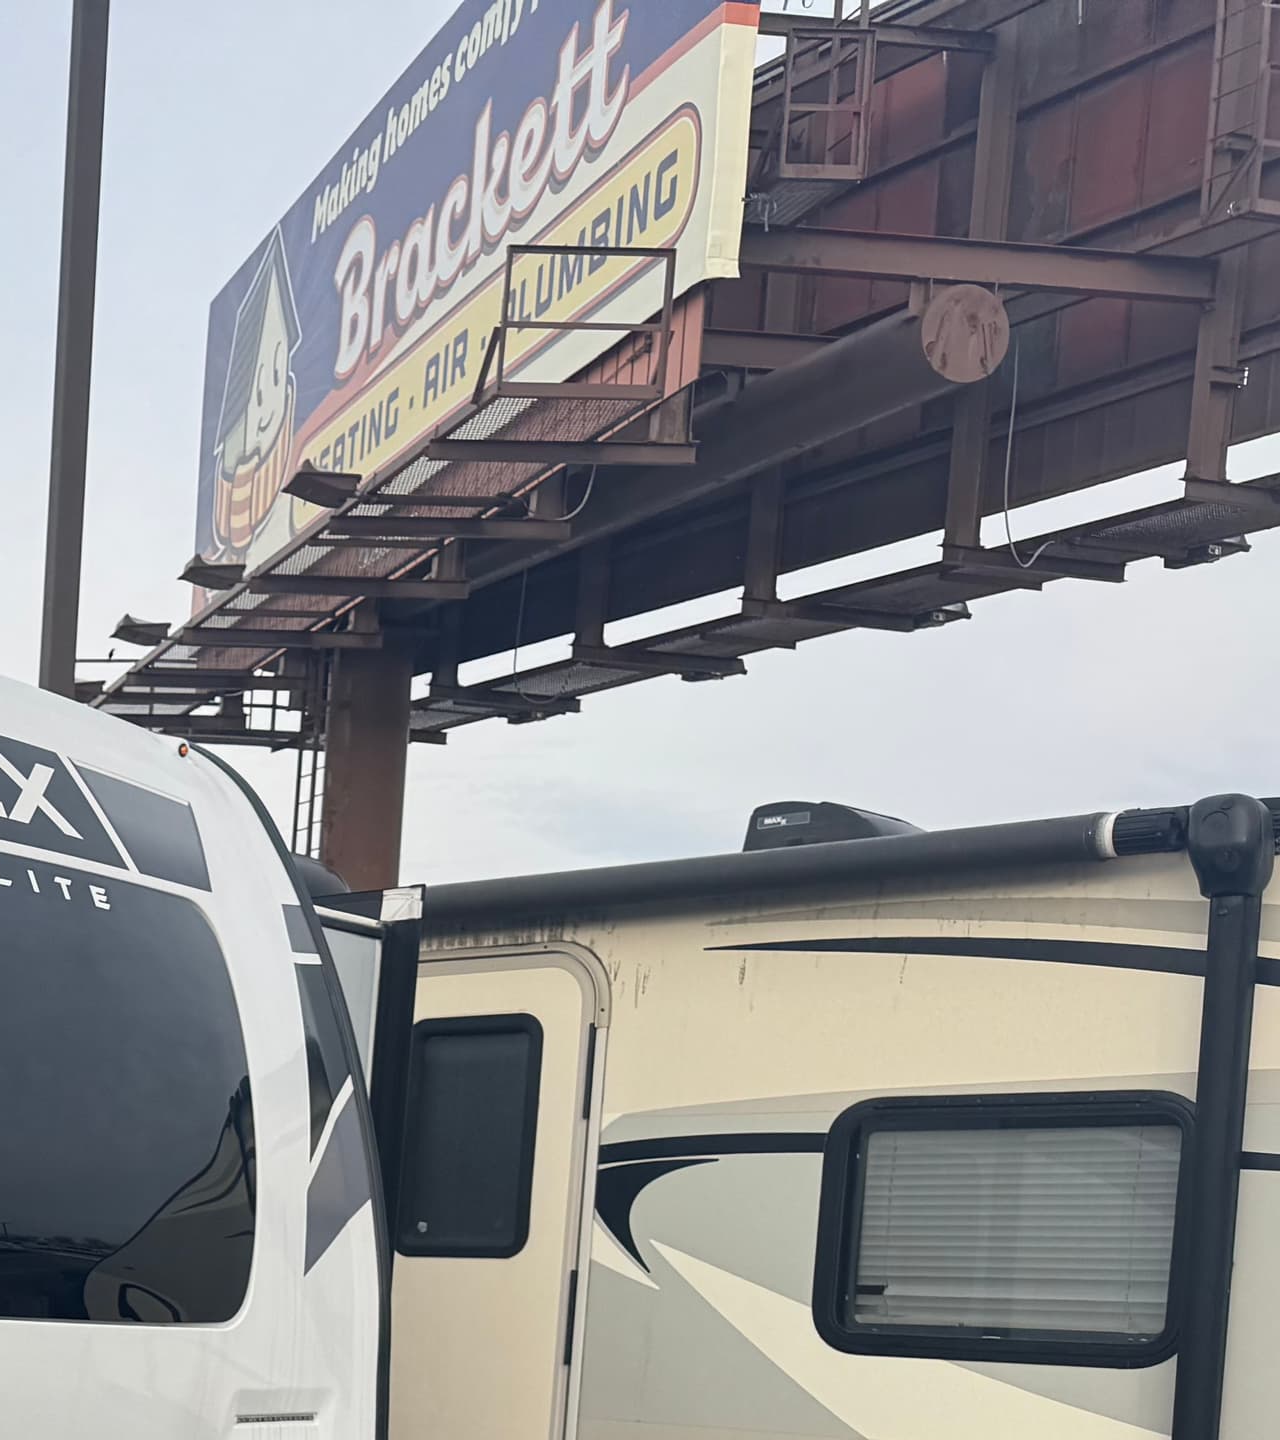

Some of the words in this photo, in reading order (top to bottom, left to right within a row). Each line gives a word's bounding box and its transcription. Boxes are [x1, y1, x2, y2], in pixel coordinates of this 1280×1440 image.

[310, 132, 383, 244] Making
[383, 52, 453, 164] homes
[334, 0, 630, 381] Brackett
[310, 386, 400, 476] EATING
[422, 327, 469, 410] AIR
